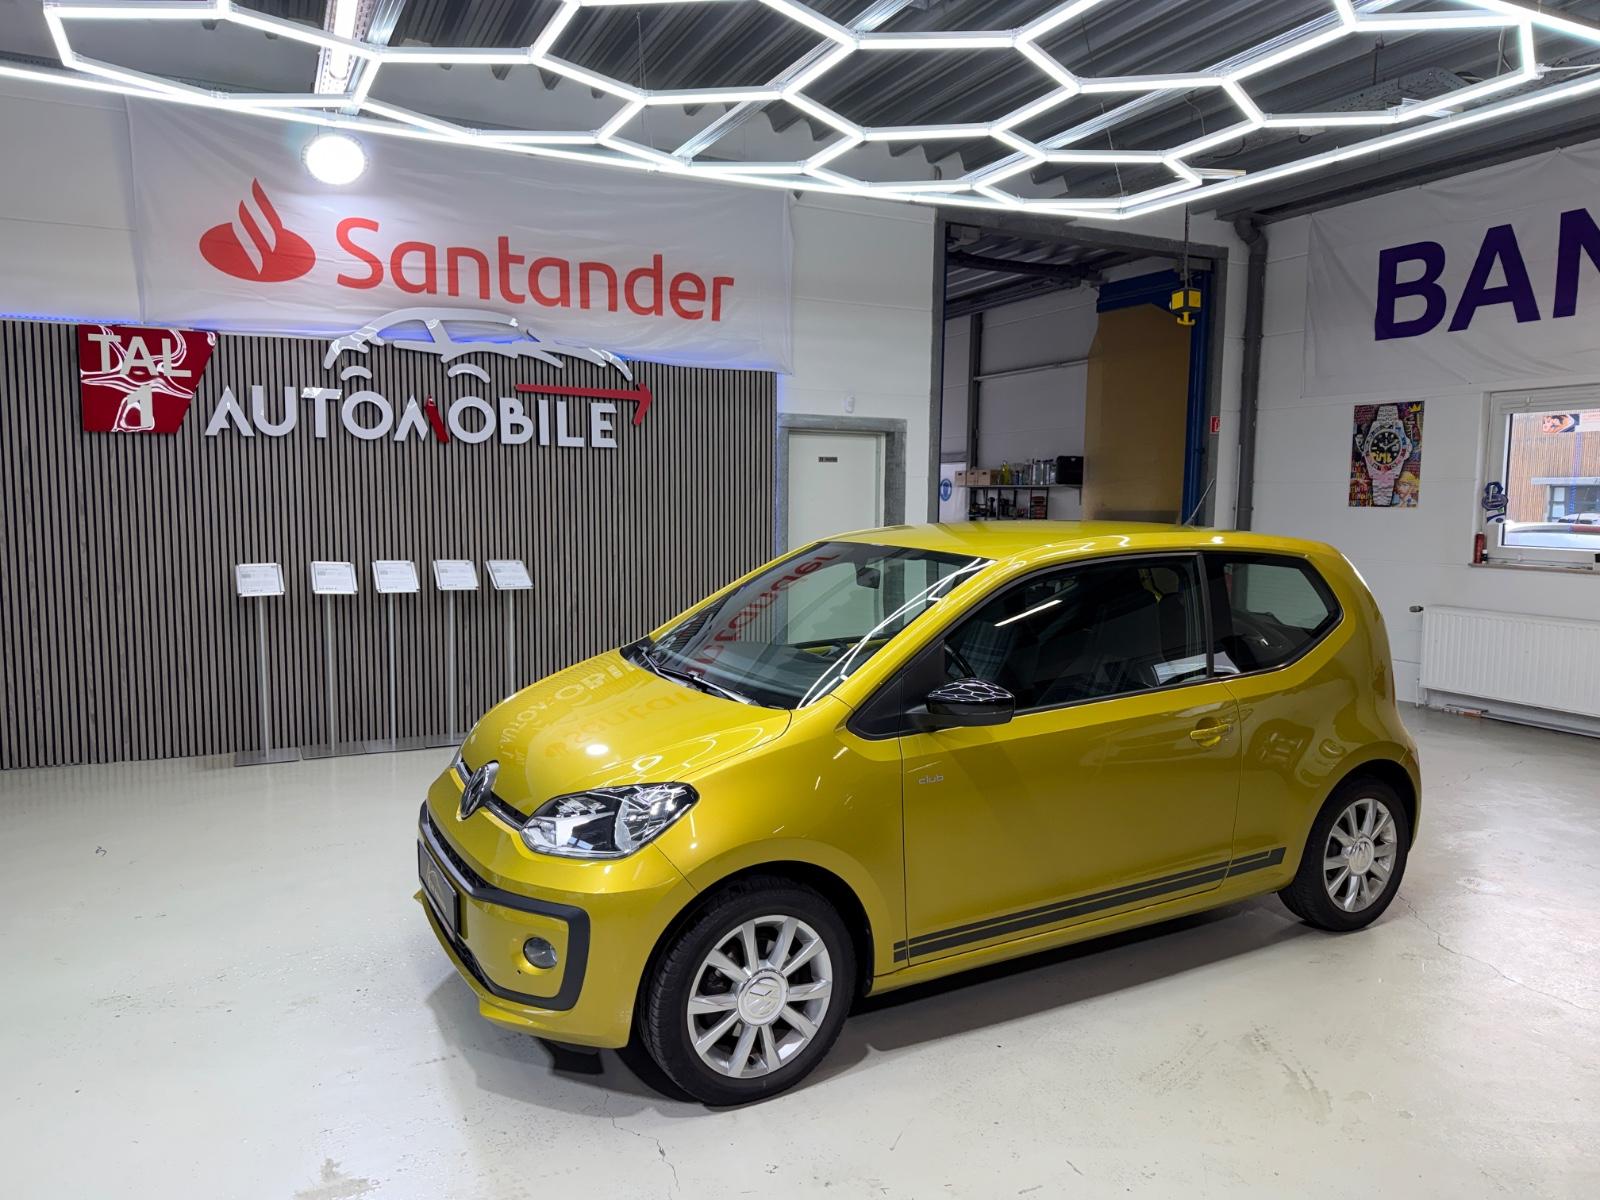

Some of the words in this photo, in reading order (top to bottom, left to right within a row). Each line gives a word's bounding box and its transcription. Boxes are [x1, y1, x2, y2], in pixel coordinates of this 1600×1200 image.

[336, 216, 735, 322] Santander
[88, 333, 192, 378] TAL
[126, 384, 154, 428] 1
[204, 384, 618, 449] AUTOMOBILE
[918, 774, 944, 785] club
